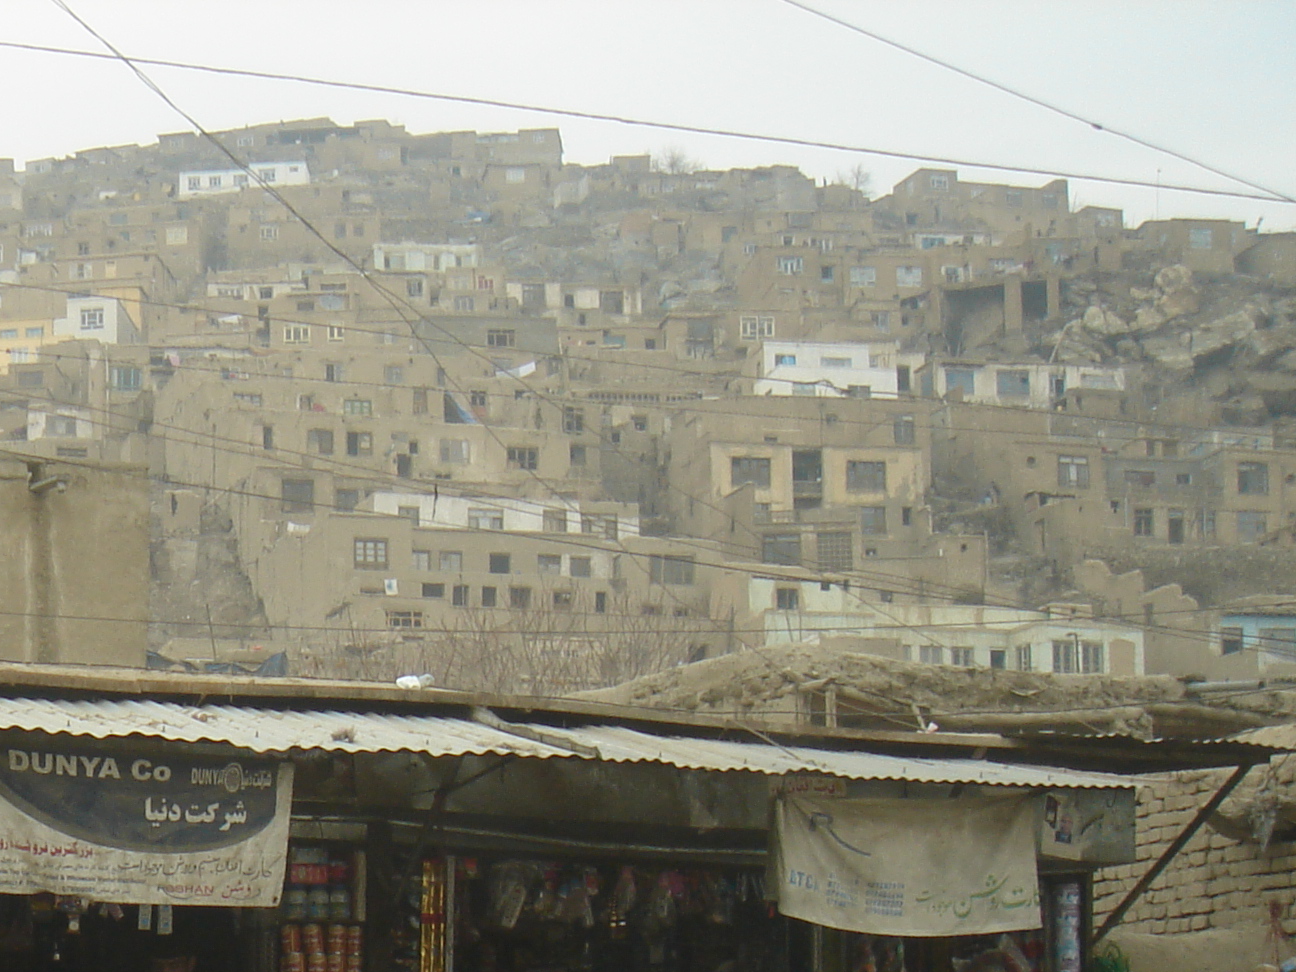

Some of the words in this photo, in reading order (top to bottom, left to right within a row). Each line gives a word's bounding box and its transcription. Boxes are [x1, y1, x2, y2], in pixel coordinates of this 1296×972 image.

[7, 748, 122, 780] DUNYA
[130, 758, 172, 782] Co
[143, 796, 182, 828] دنیا
[184, 799, 248, 832] شرکت
